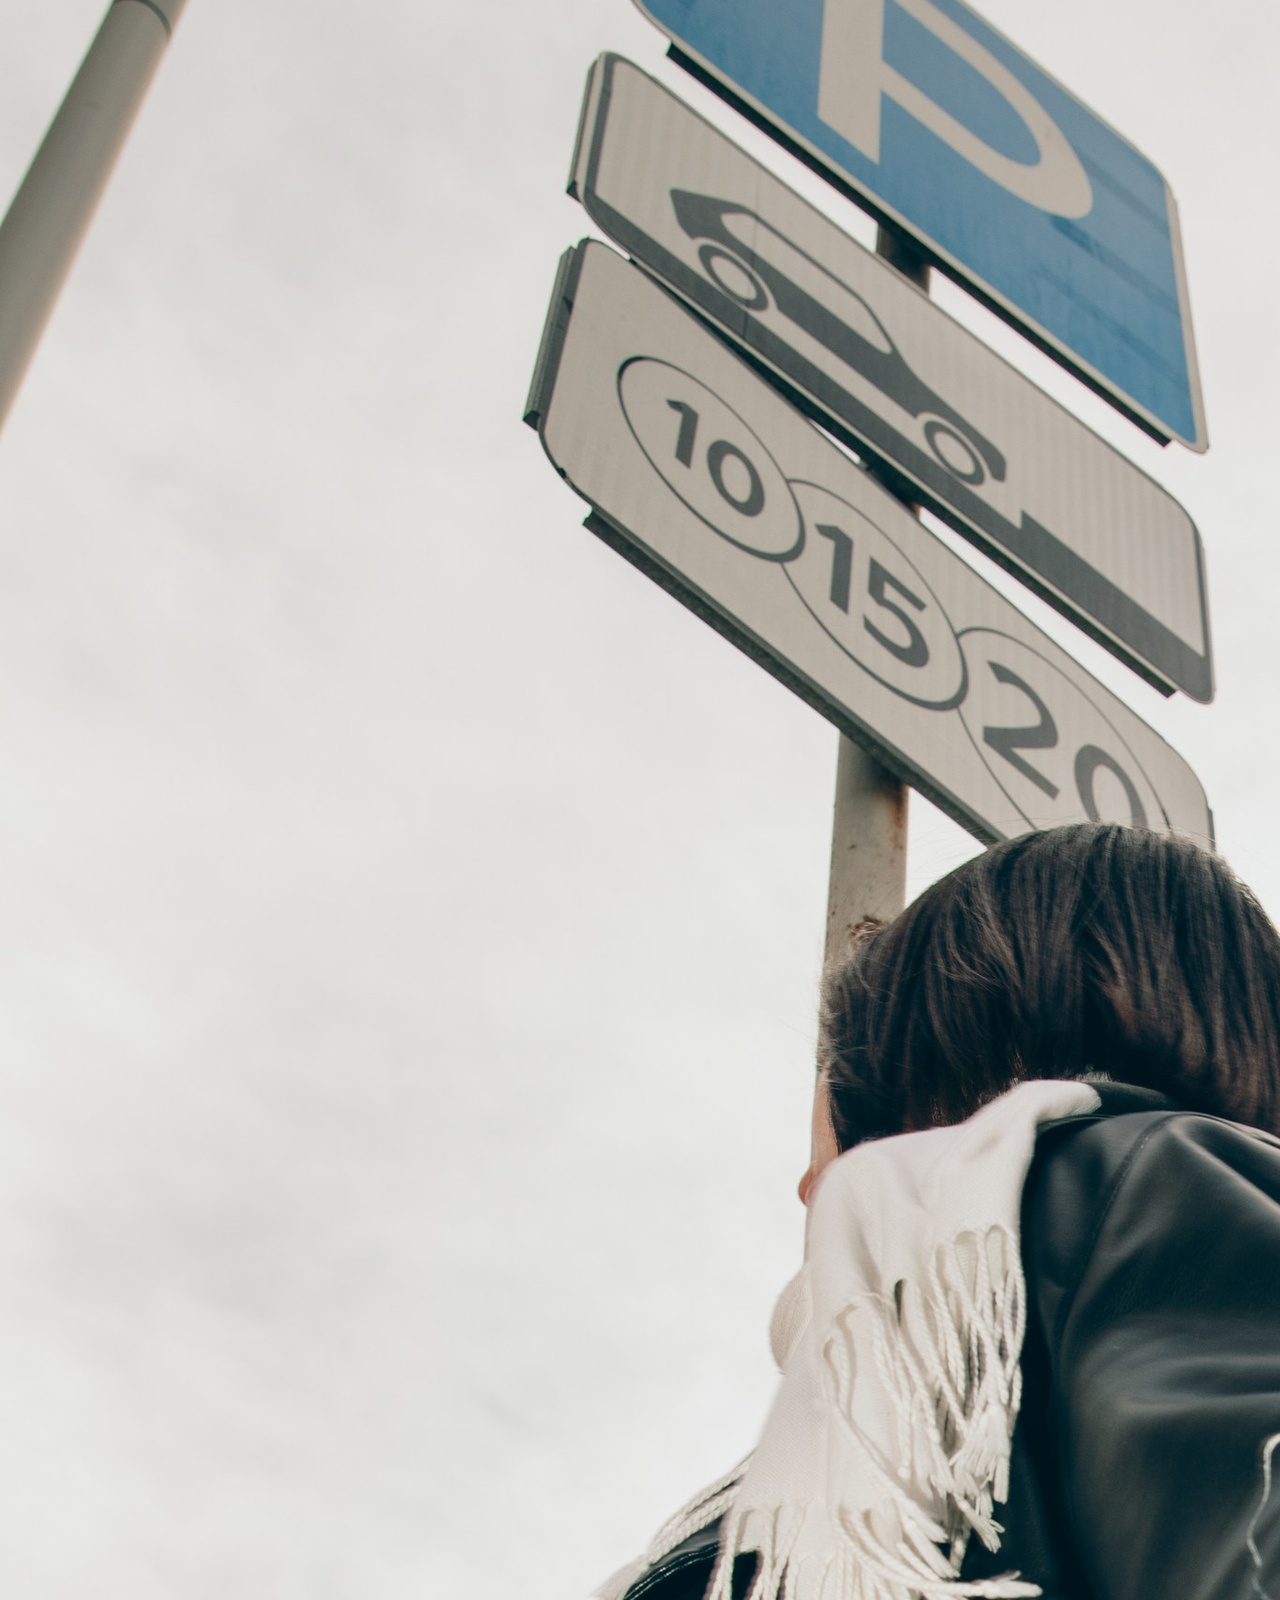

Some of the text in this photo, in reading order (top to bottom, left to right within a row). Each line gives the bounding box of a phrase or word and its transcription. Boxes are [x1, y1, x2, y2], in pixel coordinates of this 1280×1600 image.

[817, 0, 1093, 219] P
[666, 398, 765, 517] 10
[814, 523, 930, 668] 15
